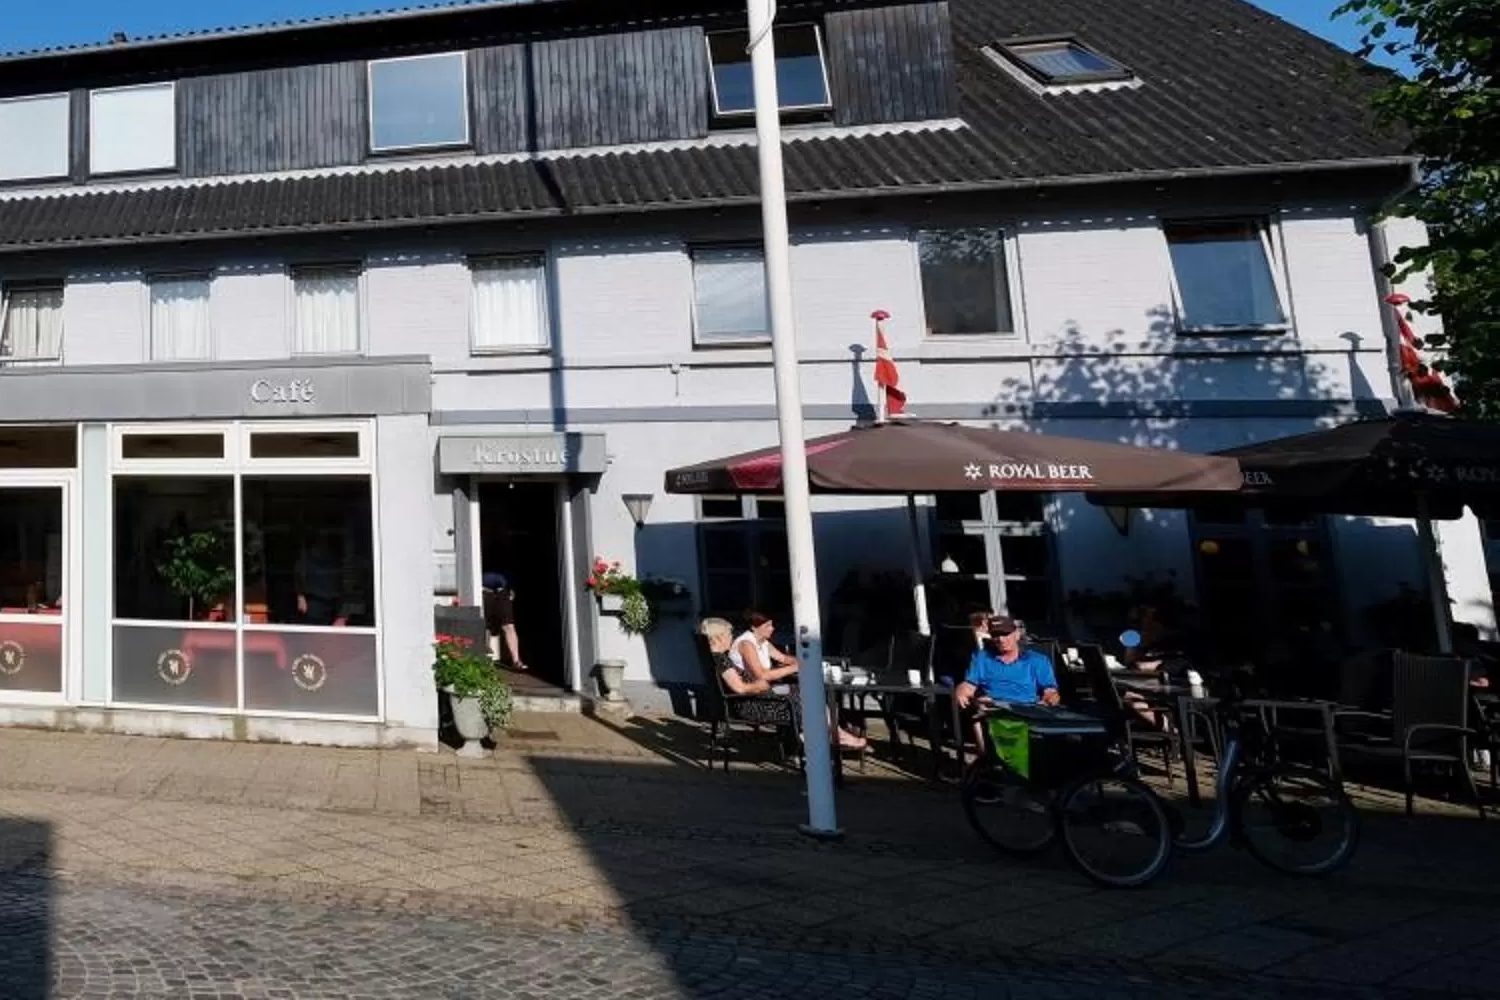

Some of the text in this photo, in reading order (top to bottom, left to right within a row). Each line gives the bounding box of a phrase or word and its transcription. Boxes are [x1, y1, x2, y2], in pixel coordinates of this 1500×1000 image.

[251, 378, 315, 403] Café
[988, 464, 1093, 479] ROYAL BEER
